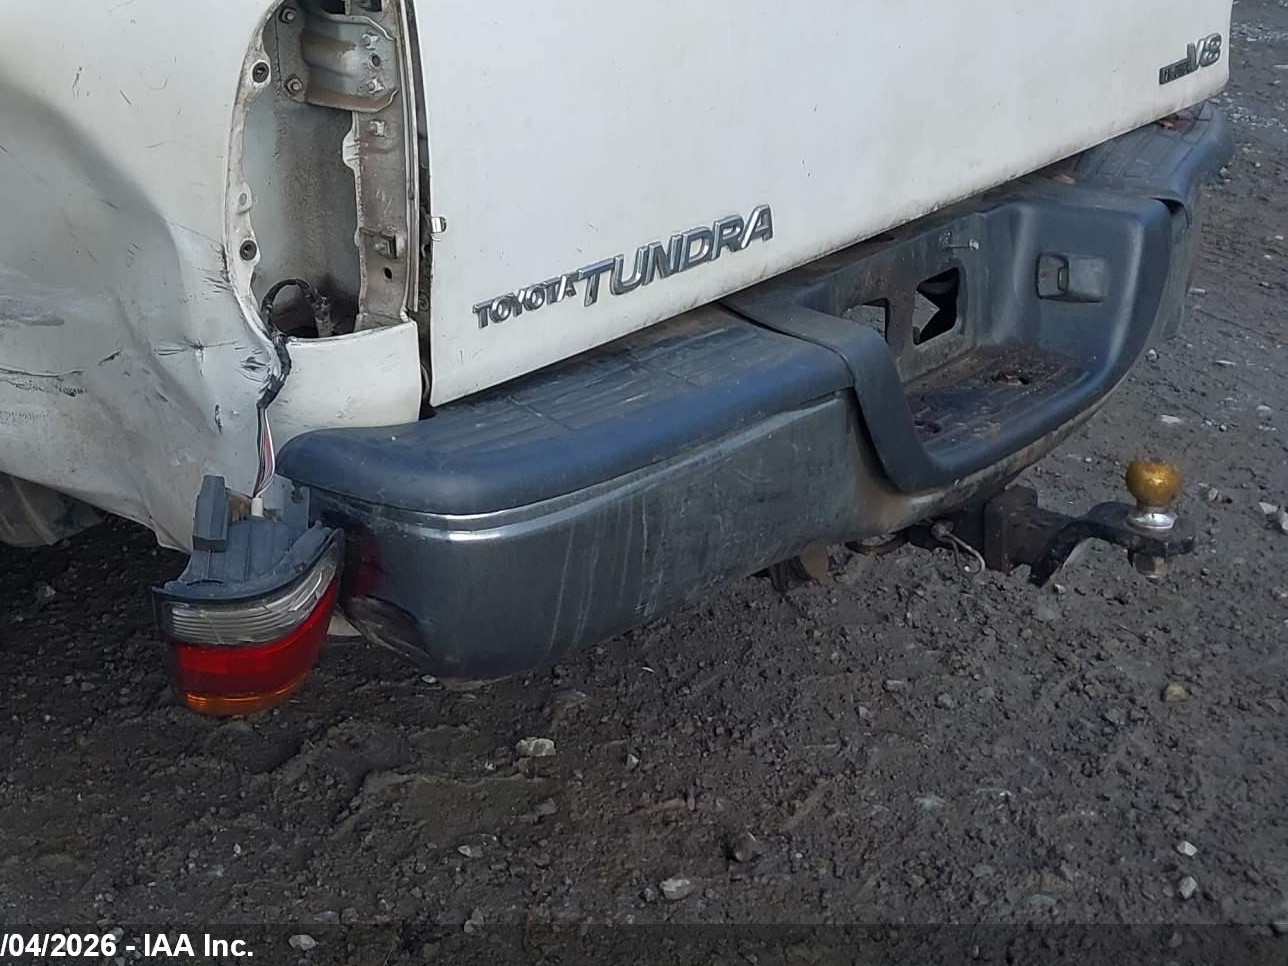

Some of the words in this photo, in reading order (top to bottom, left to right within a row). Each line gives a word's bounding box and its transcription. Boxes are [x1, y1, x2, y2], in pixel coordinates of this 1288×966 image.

[1187, 32, 1222, 72] V8
[472, 272, 577, 330] TOYOTA
[577, 203, 774, 307] TUNDRA
